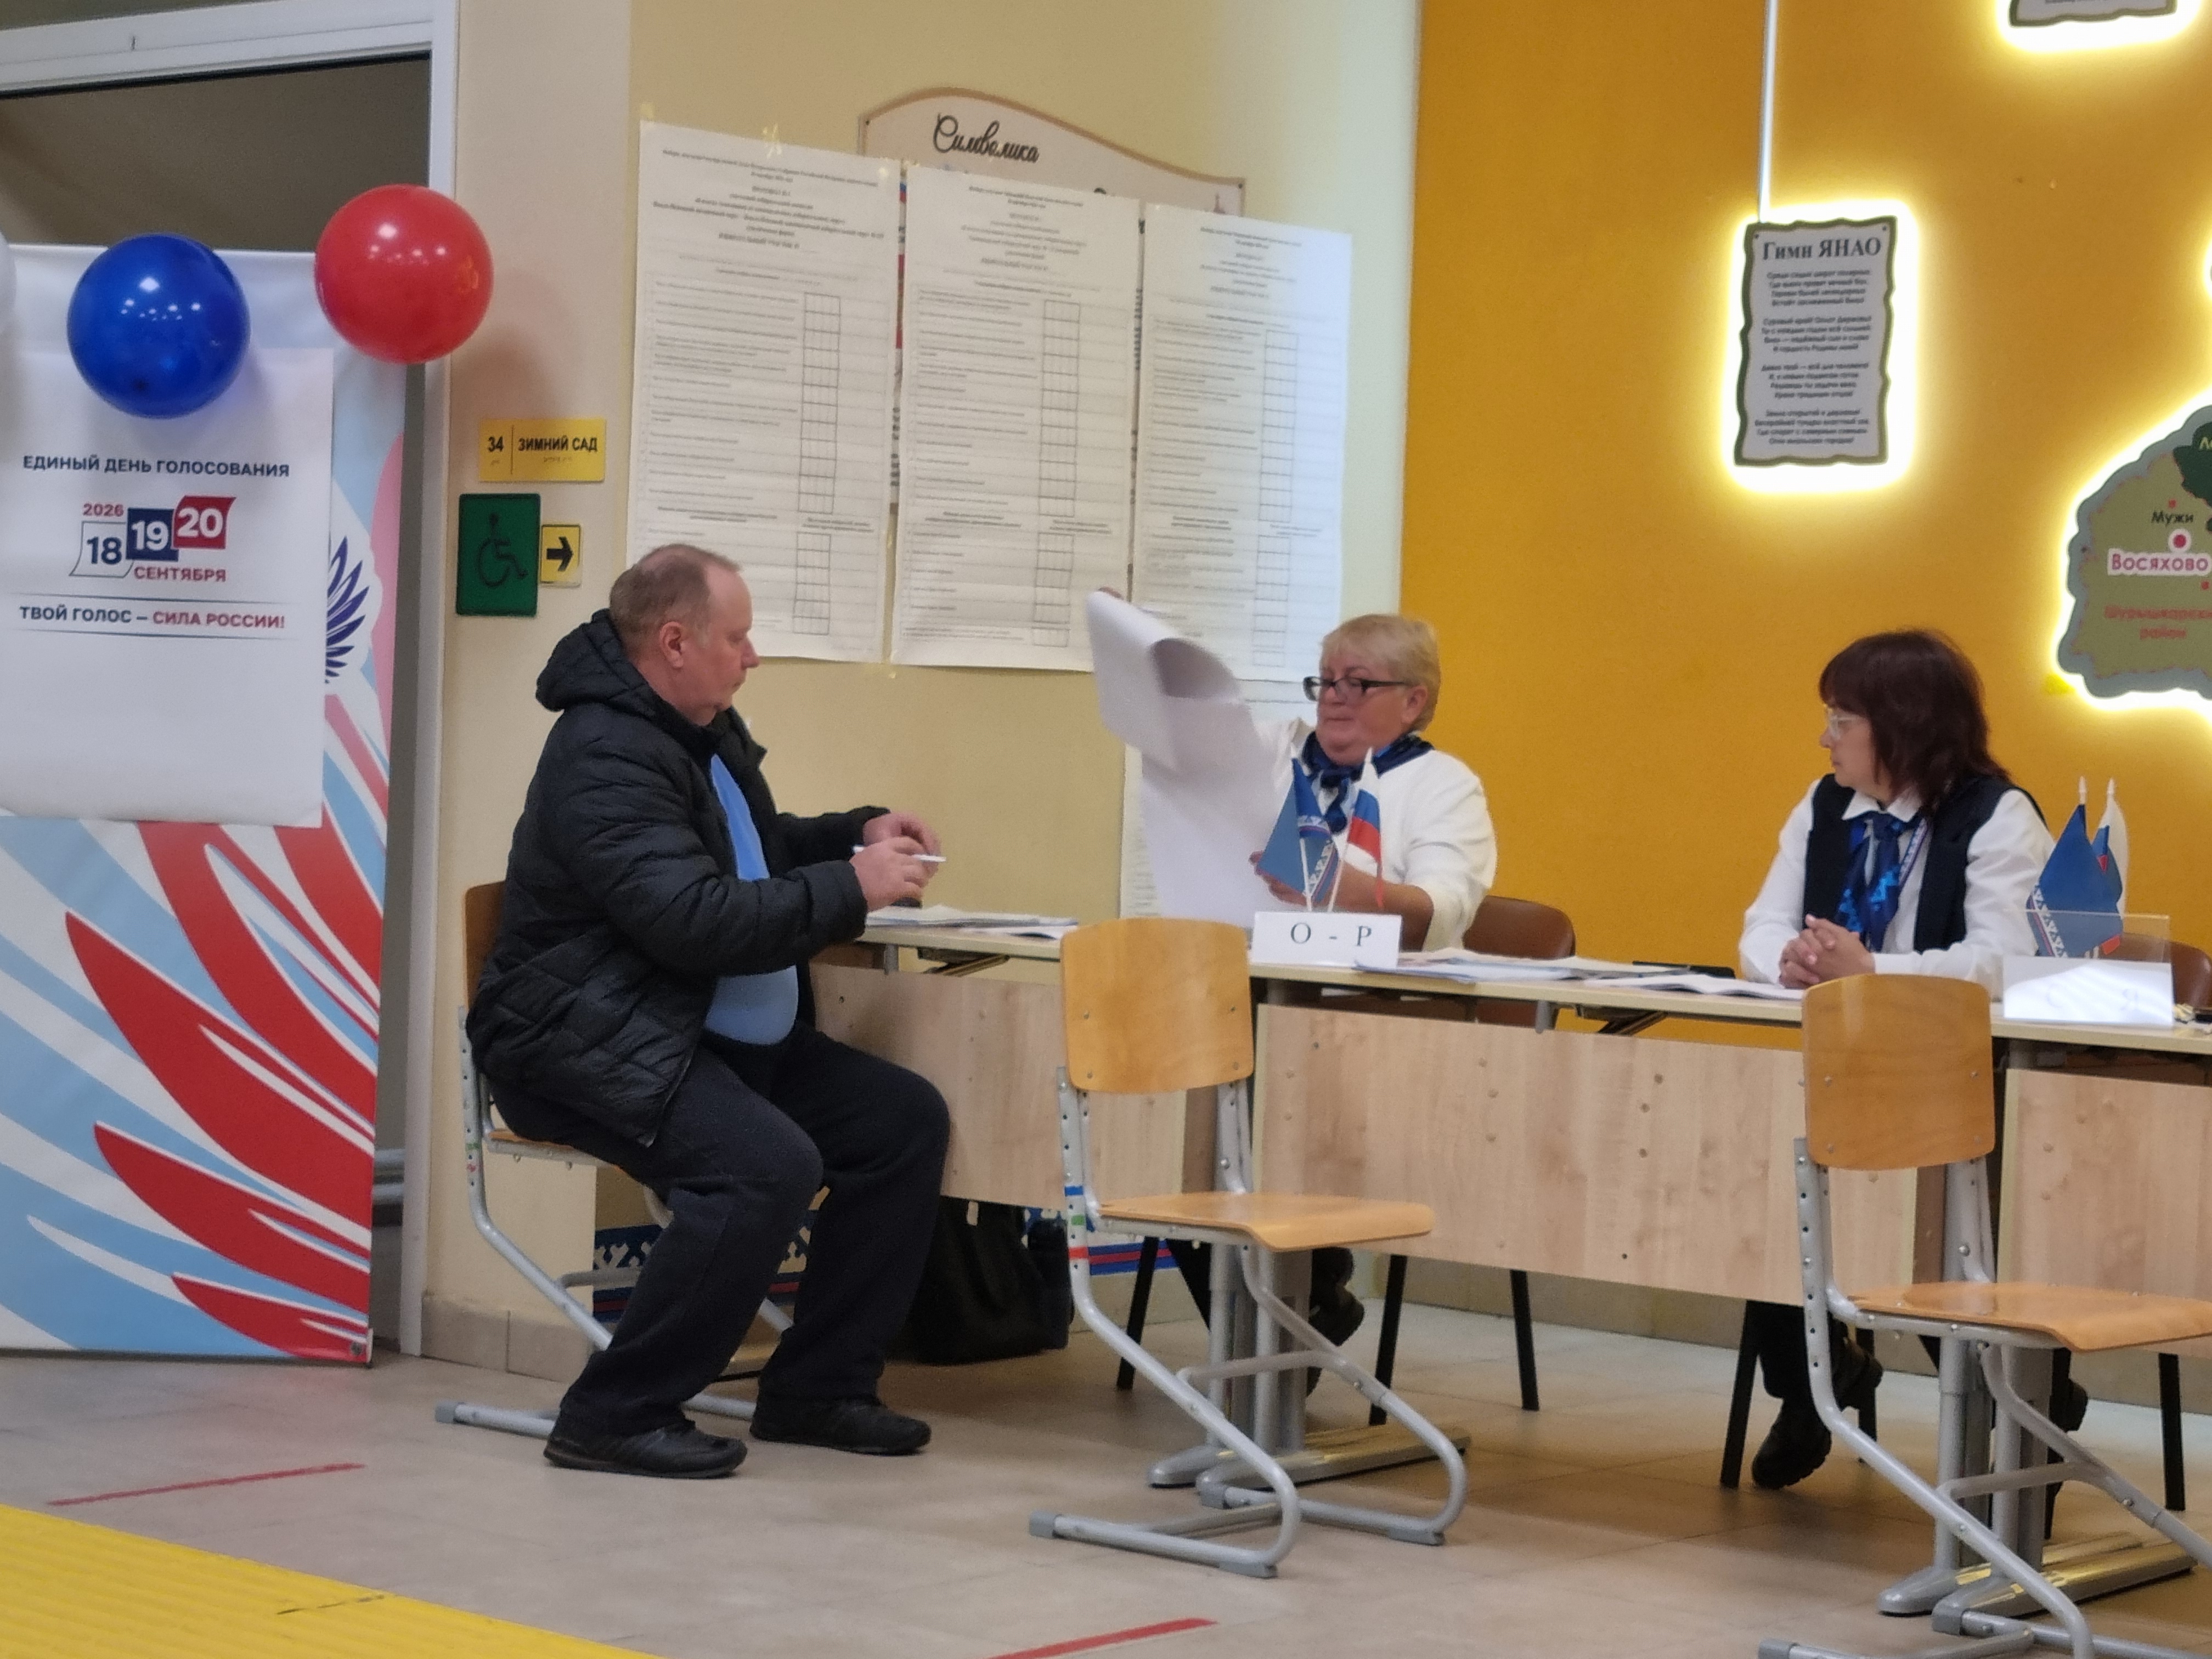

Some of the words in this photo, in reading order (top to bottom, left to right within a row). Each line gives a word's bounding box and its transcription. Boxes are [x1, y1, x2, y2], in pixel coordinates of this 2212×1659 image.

[933, 113, 1039, 163] Символика
[1763, 241, 1813, 261] Гимн
[1818, 236, 1882, 258] ЯНАО
[488, 436, 504, 453] 34
[518, 434, 569, 453] ЗИМНИЙ
[571, 437, 598, 453] САД
[23, 454, 100, 471] ЕДИНЫЙ
[104, 458, 152, 473] ДЕНЬ
[156, 460, 290, 478] ГОЛОСОВАНИЯ
[82, 503, 125, 517] 2026
[2151, 510, 2194, 526] Мужи
[87, 536, 122, 566] 18
[132, 520, 170, 551] 19
[177, 507, 224, 538] 20
[2112, 553, 2209, 571] Восяхово
[133, 566, 227, 583] СЕНТЯБРЯ
[19, 604, 67, 621] ТВОЙ
[72, 608, 132, 623] ГОЛОС
[153, 611, 201, 626] СИЛА
[206, 613, 285, 629] РОССИИ!
[1290, 922, 1312, 944] О
[1356, 925, 1372, 946] Р
